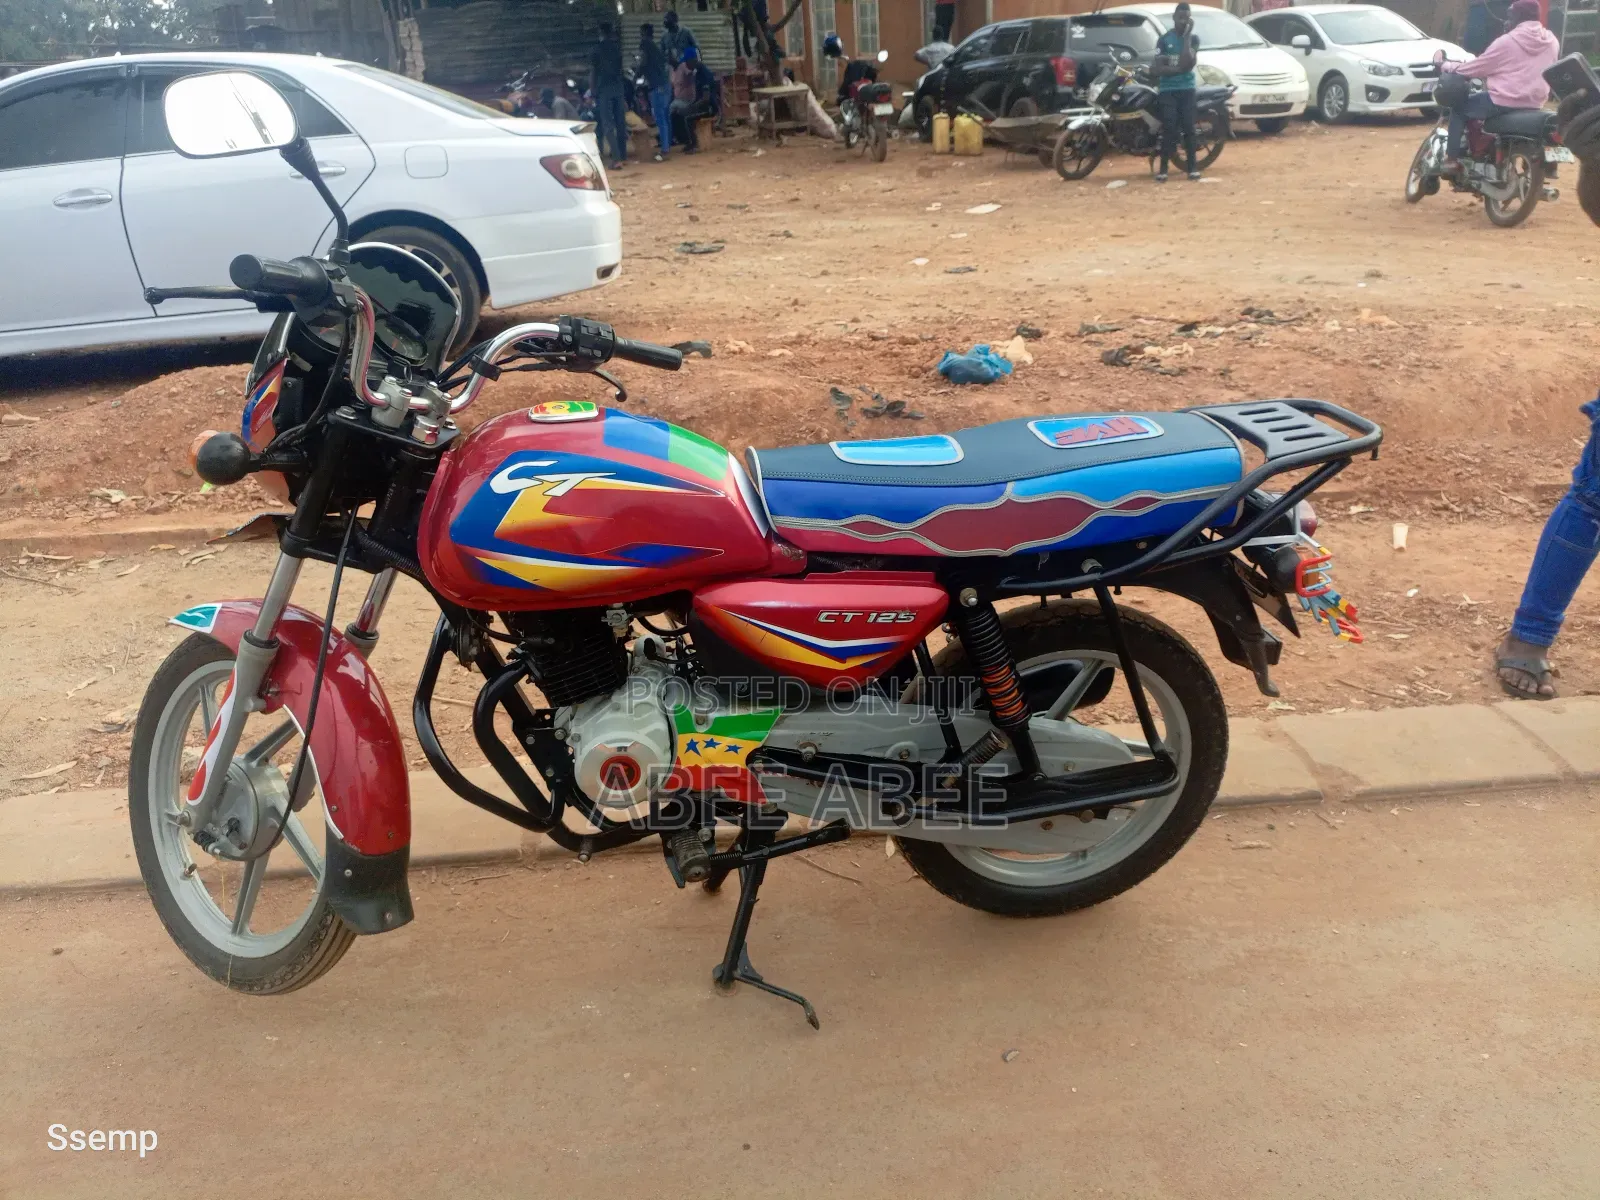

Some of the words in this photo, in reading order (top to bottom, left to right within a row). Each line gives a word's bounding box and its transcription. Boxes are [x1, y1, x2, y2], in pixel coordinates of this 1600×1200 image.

[489, 459, 617, 497] CT
[817, 611, 864, 624] CT
[866, 611, 917, 624] 125
